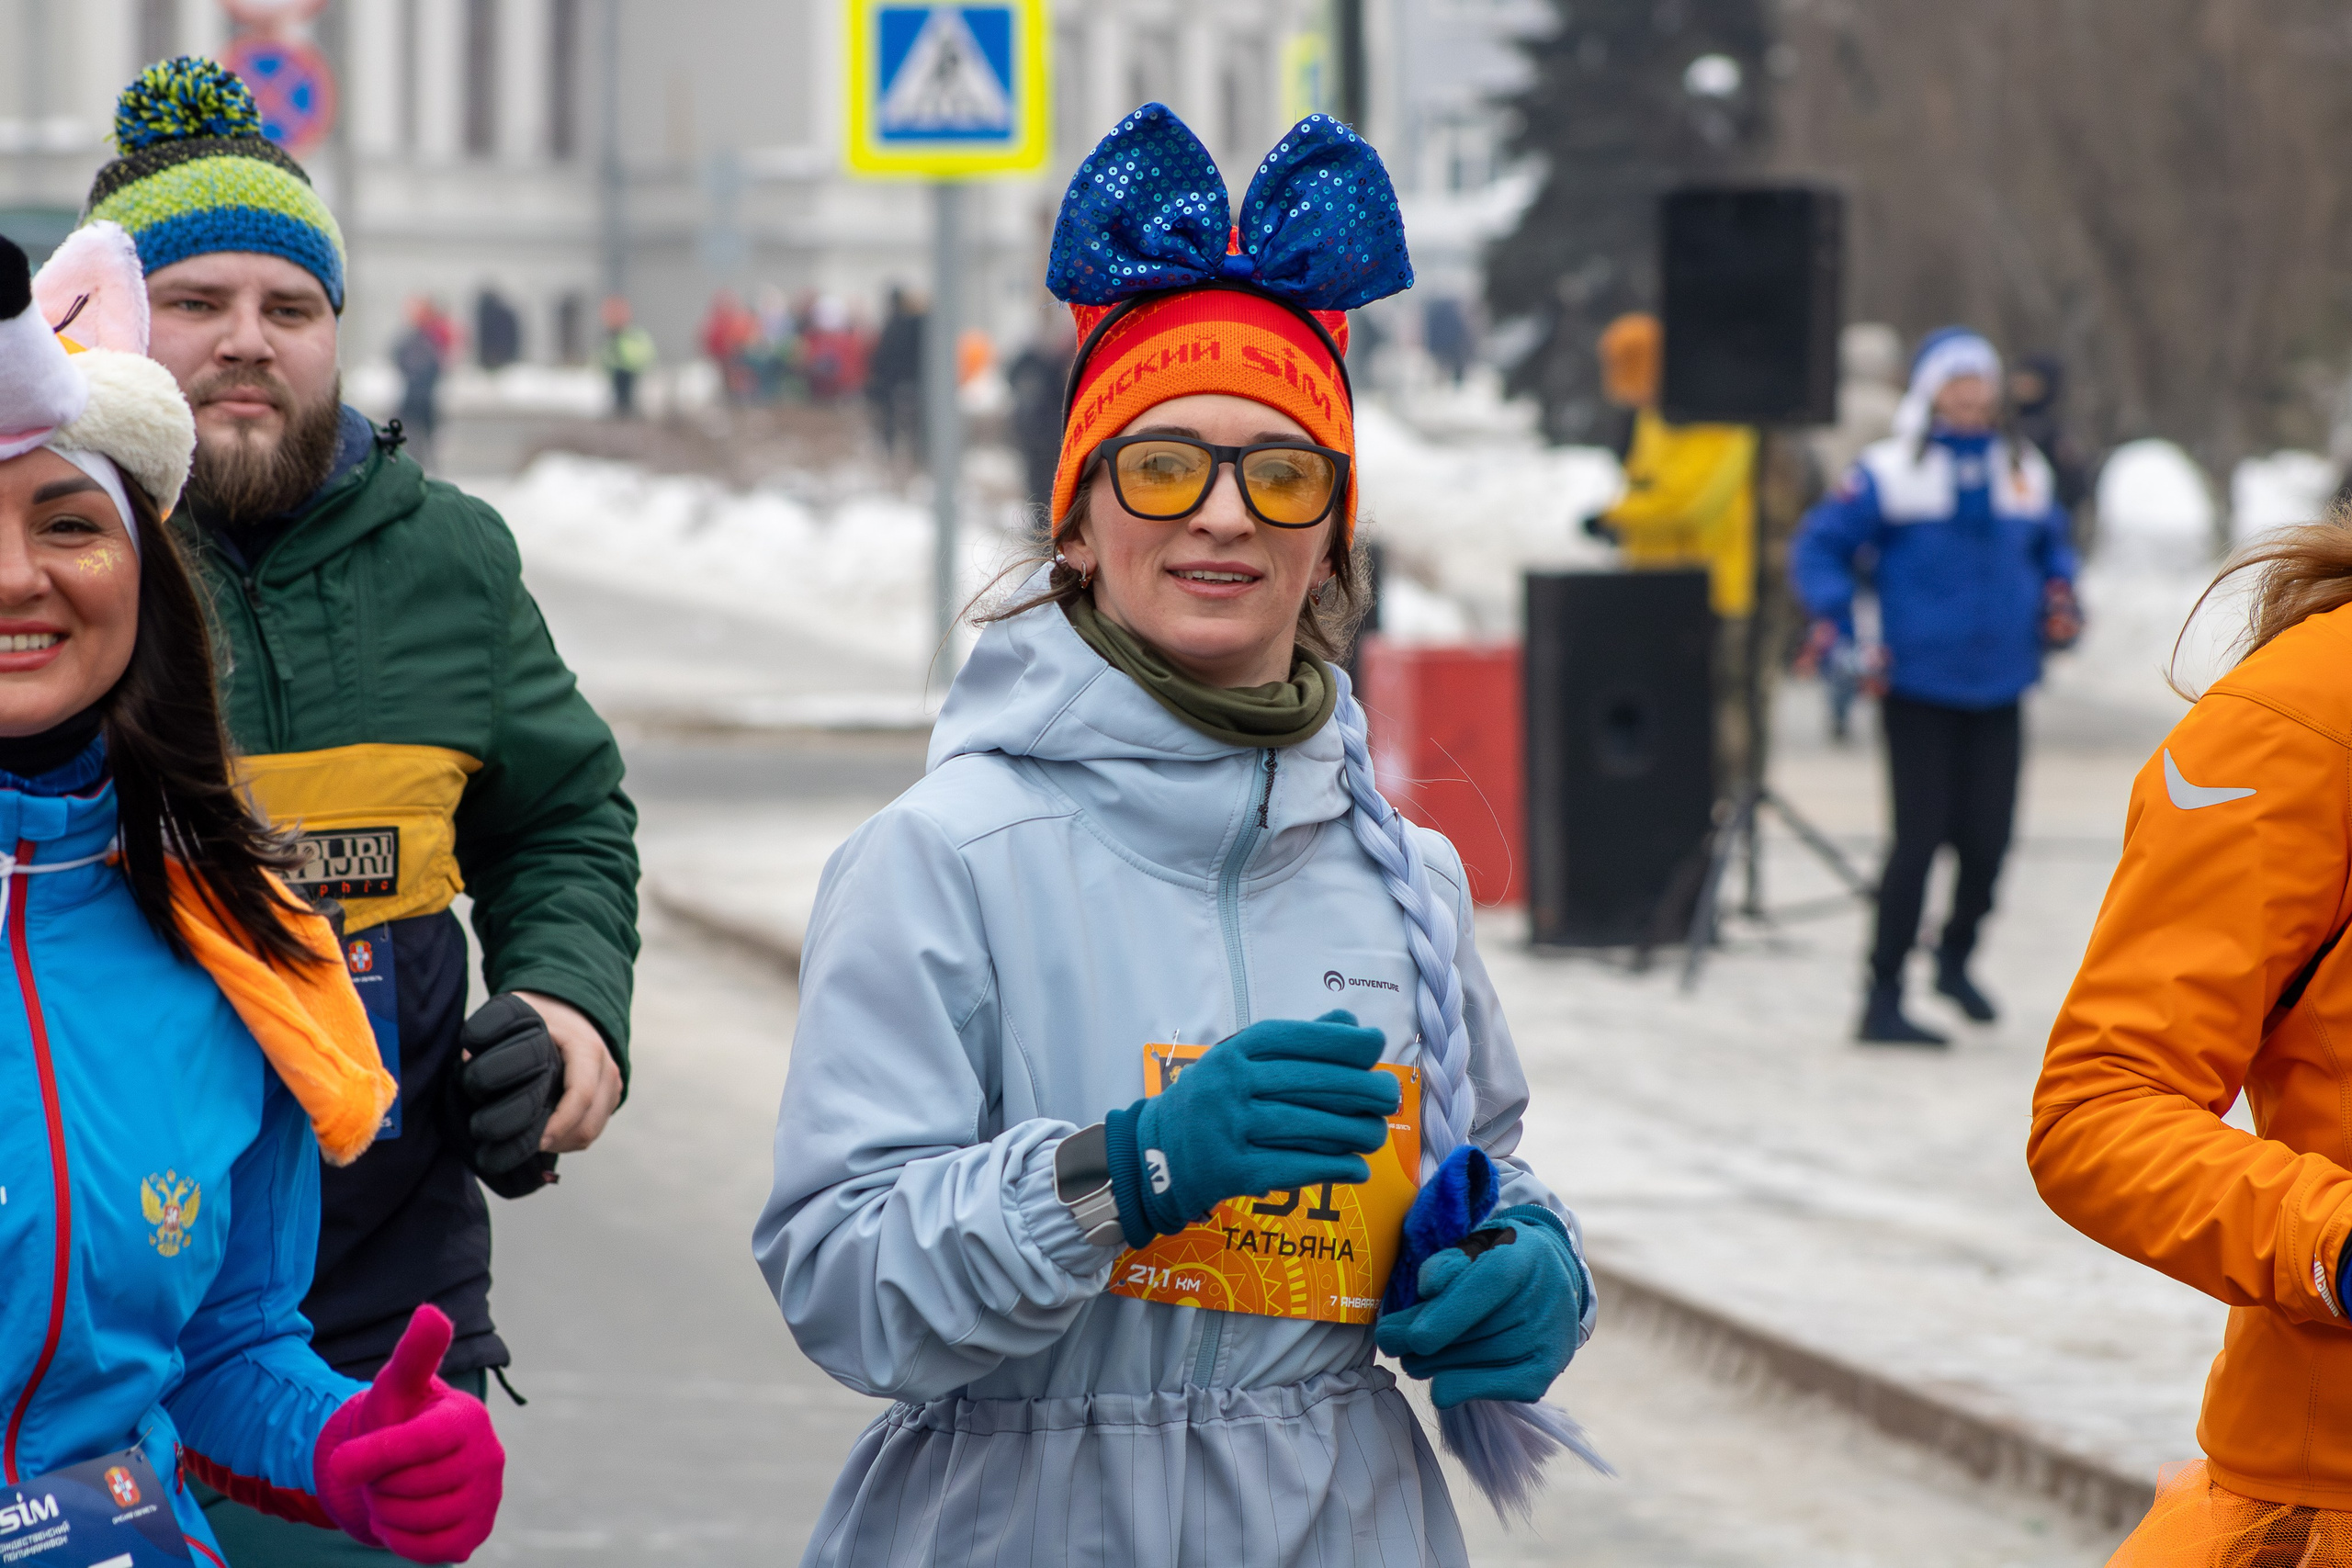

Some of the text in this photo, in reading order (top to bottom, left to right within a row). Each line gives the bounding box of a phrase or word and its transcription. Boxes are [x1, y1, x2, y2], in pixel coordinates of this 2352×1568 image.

[1348, 977, 1400, 993] OUTVENTURE
[1222, 1226, 1355, 1263] ТАТЬЯНА
[1127, 1262, 1171, 1289] 21,1
[1329, 1294, 1339, 1307] 7
[1340, 1295, 1375, 1309] ЯНВАРЯ
